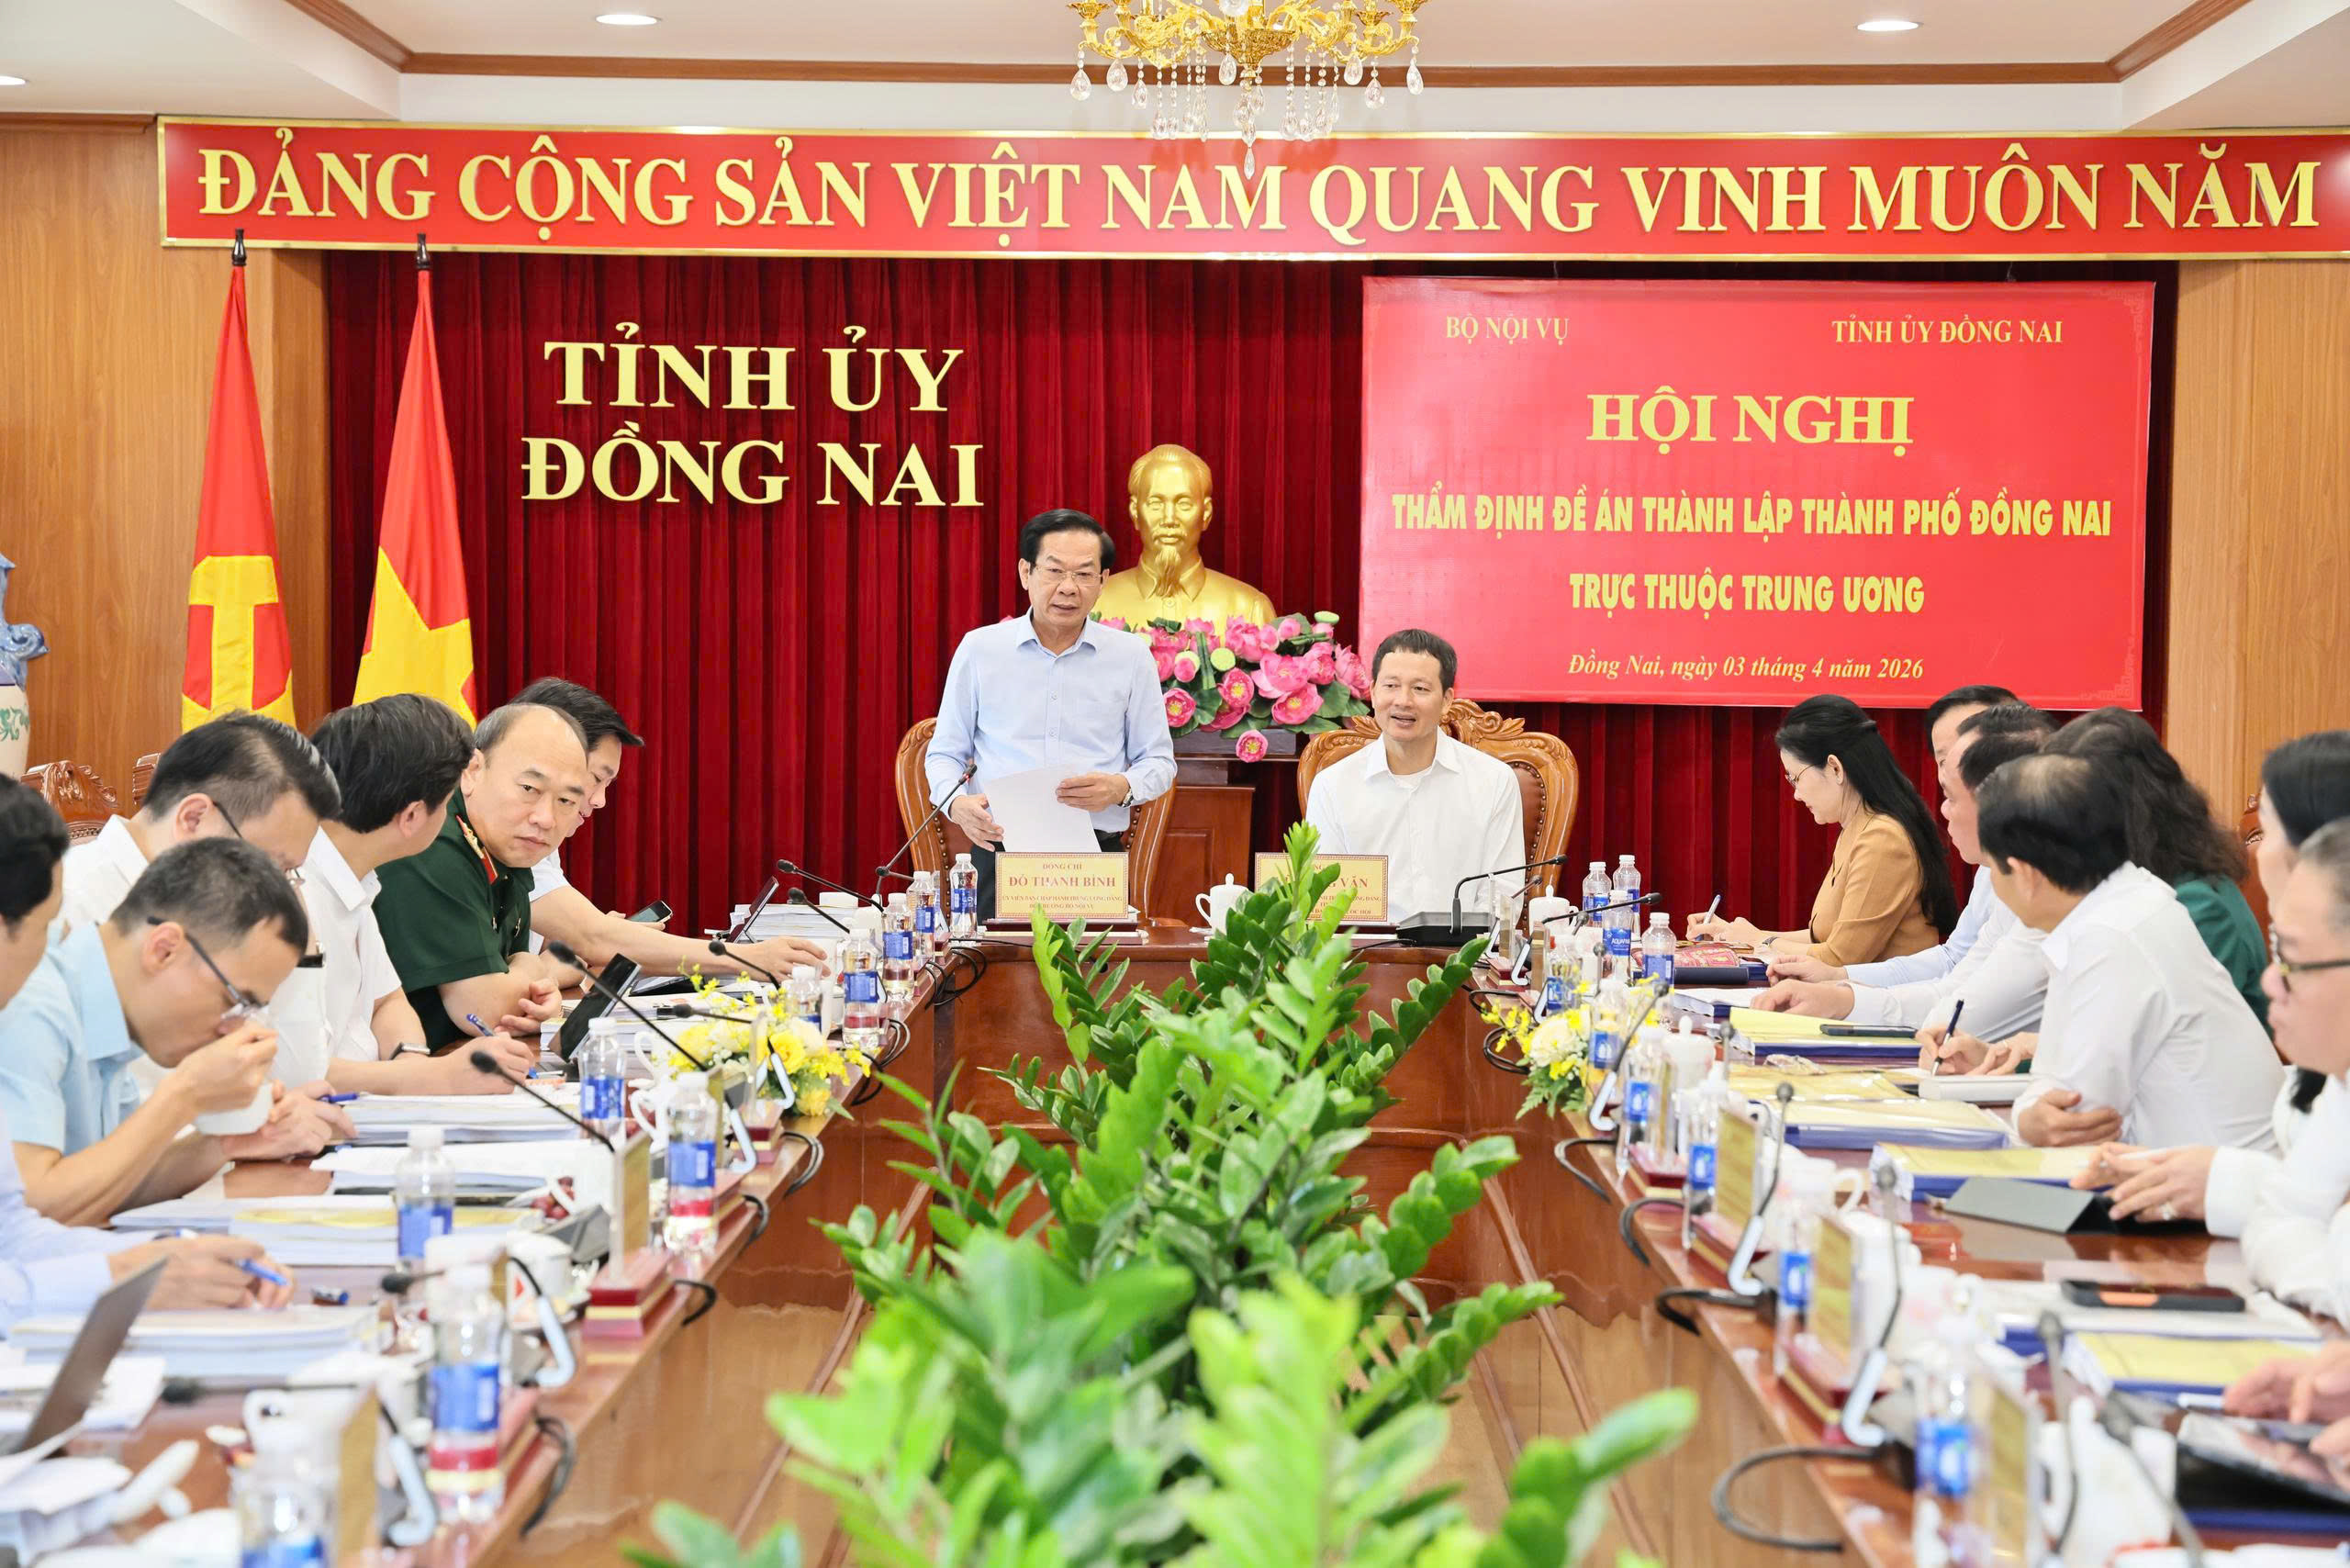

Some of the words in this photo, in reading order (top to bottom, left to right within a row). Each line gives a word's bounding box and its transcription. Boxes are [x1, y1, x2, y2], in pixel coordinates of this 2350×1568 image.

[198, 127, 435, 222] ĐẢNG
[458, 134, 693, 241] CỘNG
[714, 136, 870, 229] SẢN
[890, 141, 1080, 247] VIỆT
[1102, 163, 1288, 230] NAM
[1309, 164, 1599, 245] QUANG
[1620, 166, 1828, 233] VINH
[1847, 142, 2104, 232] MUÔN
[2123, 142, 2322, 229] NĂM
[1446, 313, 1479, 345] BỘ
[1485, 313, 1528, 345] NỘI
[1536, 318, 1570, 346] VỤ
[1831, 313, 1893, 343] TỈNH
[1900, 313, 1934, 343] ỦY
[1939, 313, 2012, 343] ĐỒNG
[2019, 320, 2064, 343] NAI
[543, 321, 796, 410] TỈNH
[822, 325, 964, 412] ỦY
[1586, 386, 1717, 455] HỘI
[1733, 395, 1915, 457] NGHỊ
[520, 420, 789, 505] ĐỒNG
[816, 442, 984, 507] NAI
[1392, 480, 1468, 530] THẨM
[1474, 495, 1544, 540] ĐỊNH
[1552, 484, 1587, 532] ĐỀ
[1594, 488, 1633, 532] ÁN
[1642, 490, 1734, 533] THÀNH
[1743, 490, 1793, 543] LẬP
[1801, 491, 1894, 535] THÀNH
[1903, 487, 1962, 536] PHỐ
[1969, 487, 2053, 537] ĐỒNG
[2063, 500, 2111, 537] NAI
[1569, 573, 1636, 619] TRỰC
[1644, 566, 1733, 620] THUỘC
[1742, 575, 1834, 612] TRUNG
[1843, 576, 1925, 613] ƯƠNG
[1568, 648, 1621, 679] Đồng
[1625, 655, 1664, 678] Nai,
[1671, 655, 1718, 681] ngày
[1723, 655, 1745, 677] 03
[1751, 656, 1807, 682] tháng
[1811, 657, 1823, 678] 4
[1829, 659, 1871, 678] năm
[1877, 658, 1923, 678] 2026
